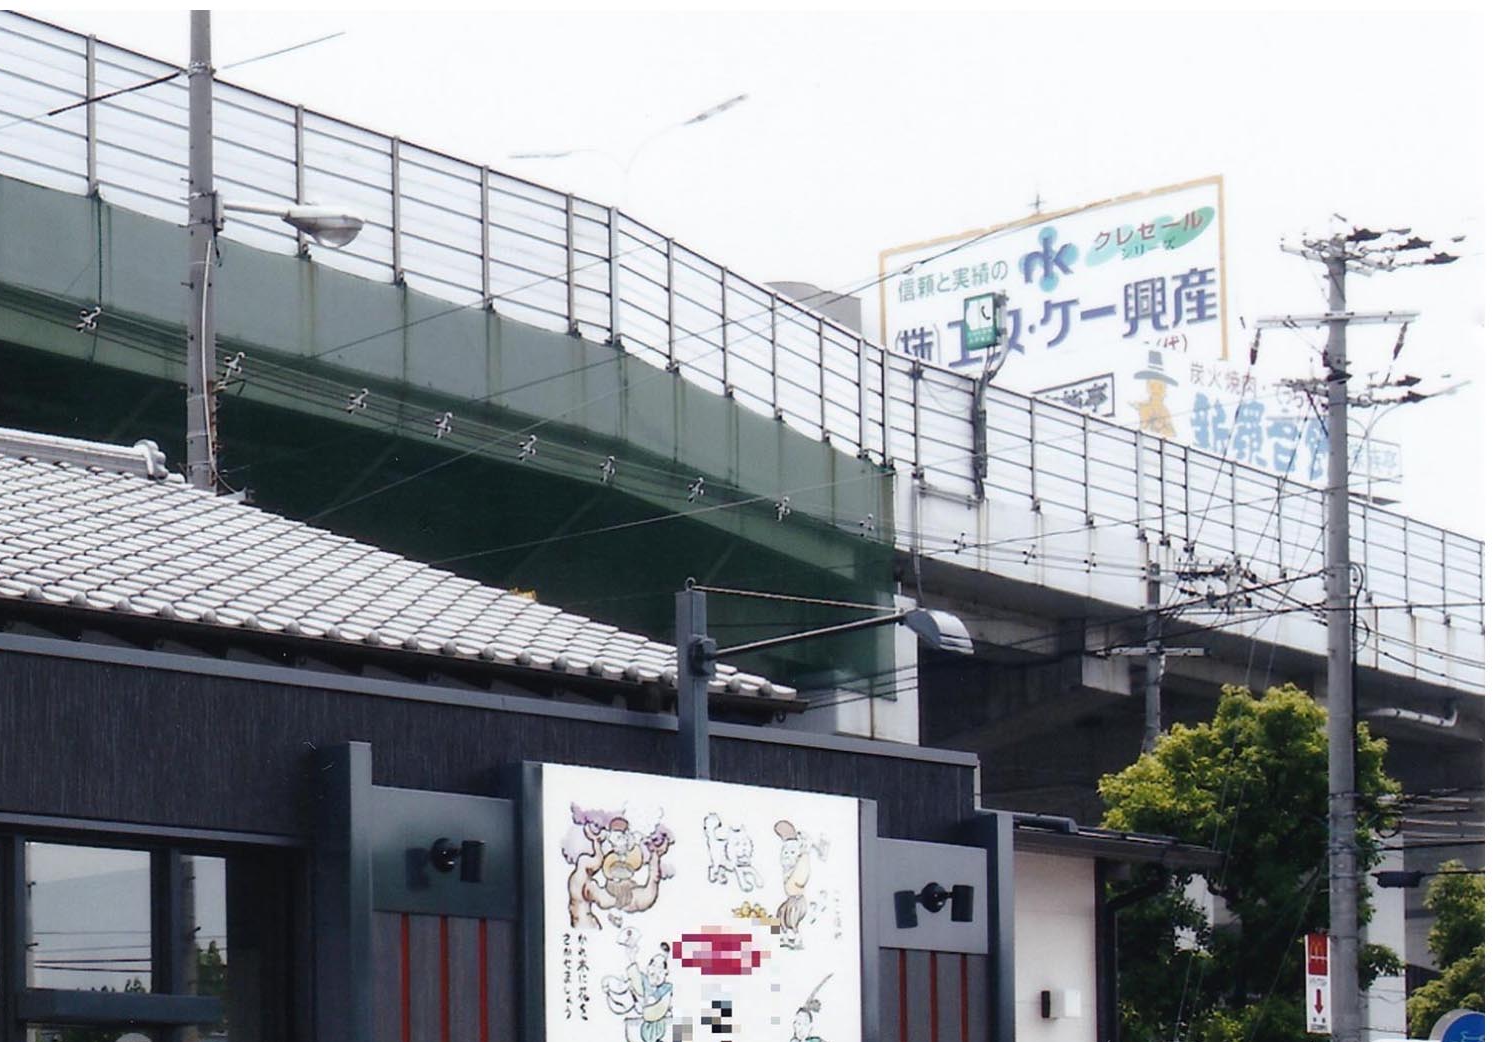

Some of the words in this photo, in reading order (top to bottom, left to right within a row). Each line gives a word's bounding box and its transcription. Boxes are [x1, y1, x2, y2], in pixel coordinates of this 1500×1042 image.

[1094, 211, 1204, 251] クレセール
[1122, 236, 1176, 260] シリーズ
[898, 260, 1008, 303] 信頼と実績の
